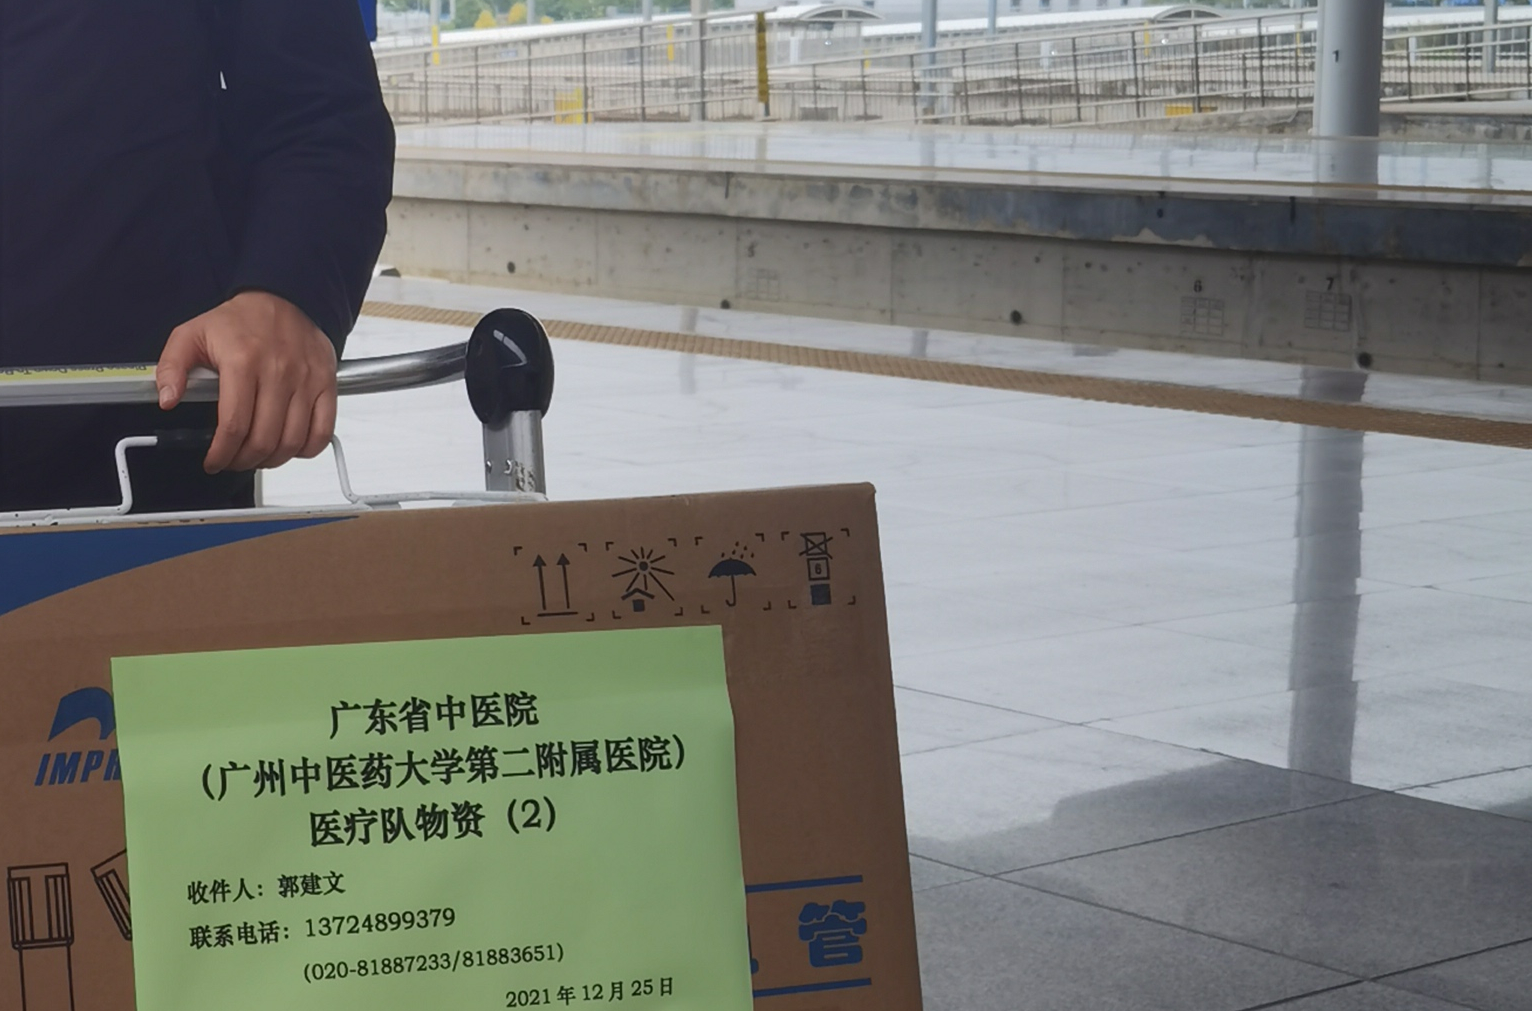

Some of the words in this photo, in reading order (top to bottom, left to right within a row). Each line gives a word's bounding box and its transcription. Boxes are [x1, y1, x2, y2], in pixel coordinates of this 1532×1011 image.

[329, 690, 540, 739] 广东省中医院
[798, 899, 868, 968] 管
[303, 942, 564, 984] (020-81887233/81883651)
